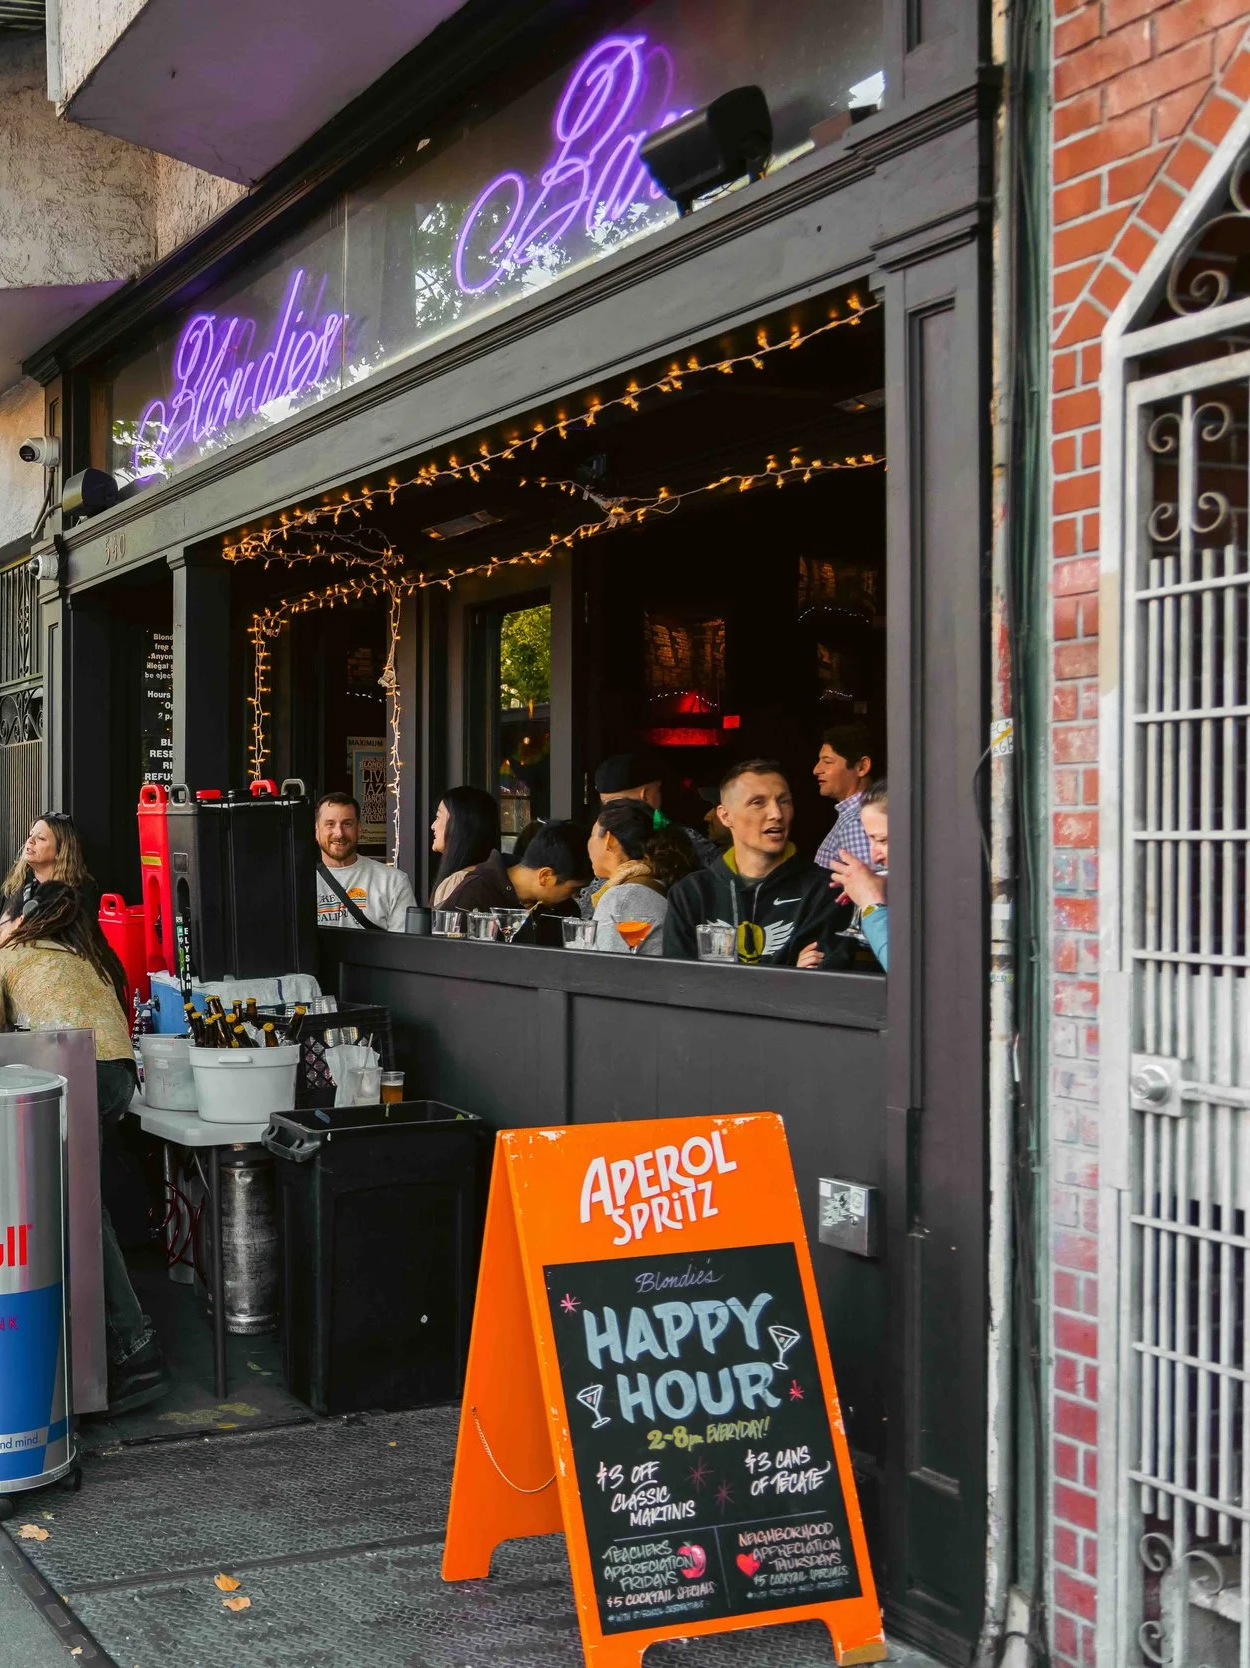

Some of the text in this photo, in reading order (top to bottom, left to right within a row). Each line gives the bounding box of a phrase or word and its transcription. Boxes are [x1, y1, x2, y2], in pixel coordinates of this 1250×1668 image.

[105, 534, 126, 565] 540
[150, 750, 173, 758] RESE
[145, 773, 173, 781] REFUS
[362, 783, 386, 796] JAZ
[580, 1131, 737, 1224] APEROL
[583, 1292, 773, 1370] HAPPY
[616, 1361, 781, 1424] HOUR
[706, 1416, 771, 1443] EVERYDAY!
[744, 1446, 810, 1475] $3 CANS
[596, 1461, 660, 1492] $3 OFF
[751, 1461, 831, 1496] OF TECATE
[611, 1480, 670, 1512] CLASSIC
[630, 1500, 696, 1527] MARTINIS
[738, 1522, 834, 1547] NEIGHBORHOOD
[602, 1540, 672, 1563] TEACHERS
[753, 1536, 841, 1562] APPRECIATION
[768, 1552, 842, 1572] THURSDAYS
[604, 1554, 694, 1582] APPRECIATION
[619, 1571, 679, 1592] FRIDAYS
[606, 1581, 716, 1608] $5 COCKTAIL SPECIALS
